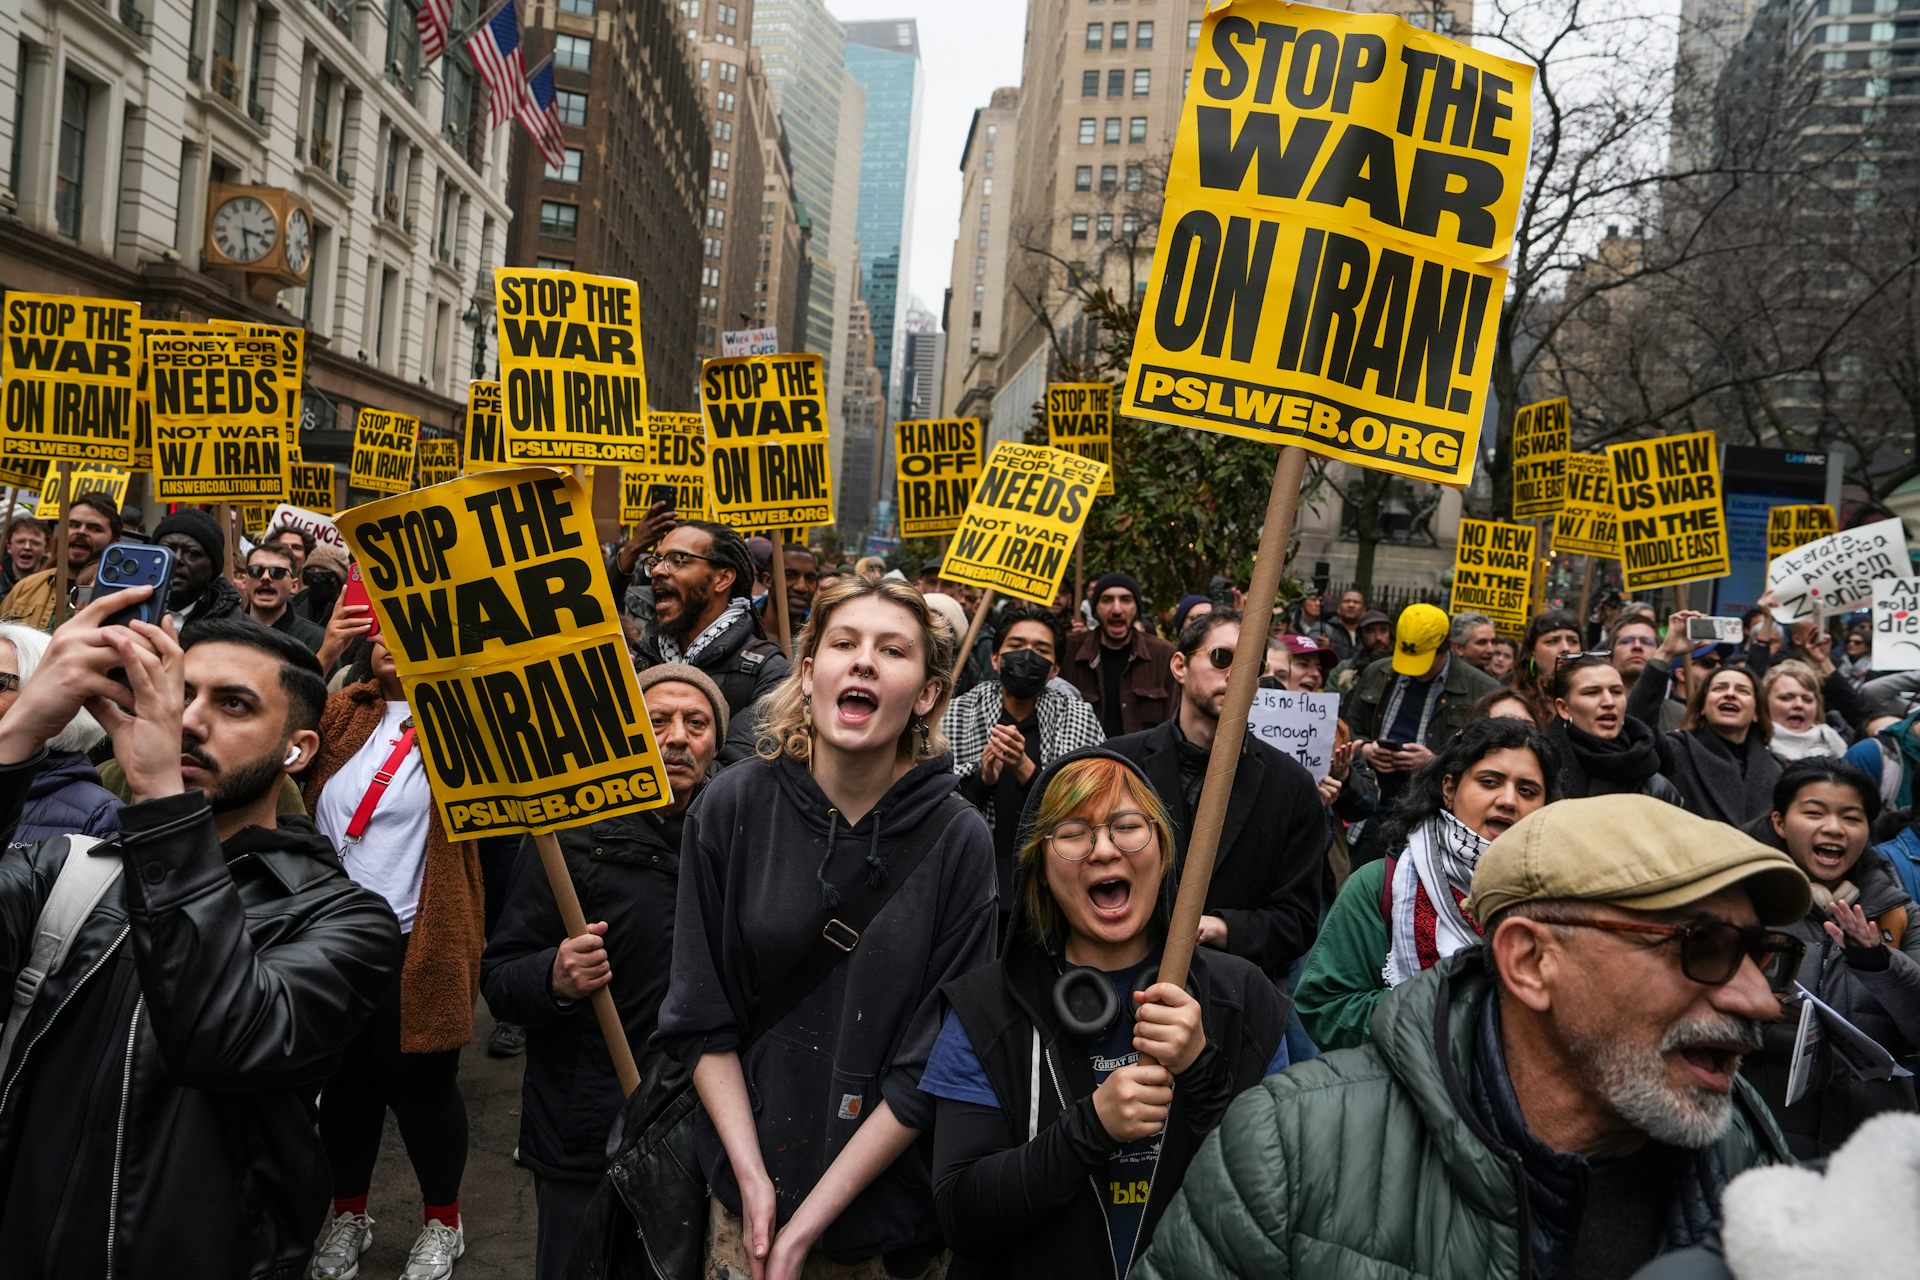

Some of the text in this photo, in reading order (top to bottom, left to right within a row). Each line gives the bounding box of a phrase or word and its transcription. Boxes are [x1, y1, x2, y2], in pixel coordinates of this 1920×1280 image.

[1203, 15, 1514, 156] STOP THE
[1196, 104, 1505, 249] WAR
[501, 276, 633, 326] STOP THE
[1154, 209, 1493, 415] ON IRAN!
[9, 300, 132, 343] STOP THE
[153, 341, 276, 352] MONEY FOR
[503, 318, 636, 365] WAR
[9, 336, 131, 377] WAR
[153, 353, 278, 367] PEOPLE'S
[154, 368, 278, 414] NEEDS
[705, 361, 818, 401] STOP THE
[6, 378, 46, 433] ON
[53, 381, 131, 440] IRAN!
[508, 368, 644, 437] ON IRAN!
[1051, 389, 1109, 412] STOP THE
[157, 426, 279, 439] NOT WAR
[360, 412, 391, 431] STOP
[394, 417, 415, 435] THE
[649, 415, 675, 424] NEY
[649, 424, 705, 434] OPLE'S
[707, 399, 822, 438] WAR
[1052, 413, 1109, 436] WAR
[1140, 369, 1459, 468] PSLWEB.ORG
[1516, 402, 1565, 437] NO NEW
[5, 439, 128, 460] PSLWEB.ORG
[359, 429, 413, 452] WAR
[420, 443, 455, 455] STOP THE
[512, 441, 644, 460] PSLWEB.ORG
[650, 434, 705, 466] EDS
[900, 422, 976, 454] HANDS
[1514, 432, 1566, 458] US WAR
[158, 442, 203, 476] W/
[214, 441, 280, 475] IRAN
[354, 449, 412, 482] ON IRAN!
[421, 455, 456, 467] WAR
[901, 452, 976, 476] OFF
[993, 454, 1096, 485] PEOPLE'S
[999, 445, 1059, 460] MONEY
[1063, 456, 1101, 473] FOR
[1516, 459, 1565, 481] IN THE
[1569, 456, 1608, 465] MONE
[1569, 464, 1610, 473] PEOP
[1613, 437, 1710, 485] NO NEW
[162, 479, 281, 495] ANSWERCOALITION.ORG
[291, 466, 331, 490] NEW
[352, 477, 409, 491] PSLWEB.ORG
[422, 470, 433, 487] ON
[625, 472, 704, 484] NOT WAR
[712, 443, 828, 505] ON IRAN!
[289, 490, 332, 508] WAR
[676, 486, 704, 509] AN
[975, 466, 1088, 524] NEEDS
[1516, 478, 1565, 503] MIDDLE EAST
[1568, 473, 1614, 505] NEE
[1617, 474, 1716, 512] US WAR
[719, 507, 828, 527] PSLWEB.ORG
[966, 515, 1011, 531] NOT
[1016, 523, 1070, 546] WAR
[1558, 516, 1618, 543] W/ IRA
[1622, 507, 1719, 542] IN THE
[1772, 509, 1832, 531] NO NEW
[355, 476, 583, 591] STOP THE
[1462, 522, 1487, 547] NO
[1491, 526, 1532, 553] NEW
[1770, 532, 1791, 547] US
[955, 528, 1064, 580] W/ IRAN
[1460, 547, 1529, 571] US WAR
[1625, 536, 1684, 570] MIDDLE
[1686, 531, 1720, 560] EAST
[947, 560, 1051, 597] ANSWERCOALITION.ORG
[1457, 570, 1526, 592] IN THE
[378, 557, 606, 663] WAR
[1455, 586, 1524, 609] MIDDLE EAST
[413, 642, 648, 789] ON IRAN!
[1265, 693, 1276, 708] is
[1279, 697, 1294, 709] no
[1297, 692, 1327, 720] flag
[1261, 723, 1318, 747] enough
[449, 772, 660, 830] PSLWEB.ORG
[1098, 1057, 1127, 1070] GREAT
